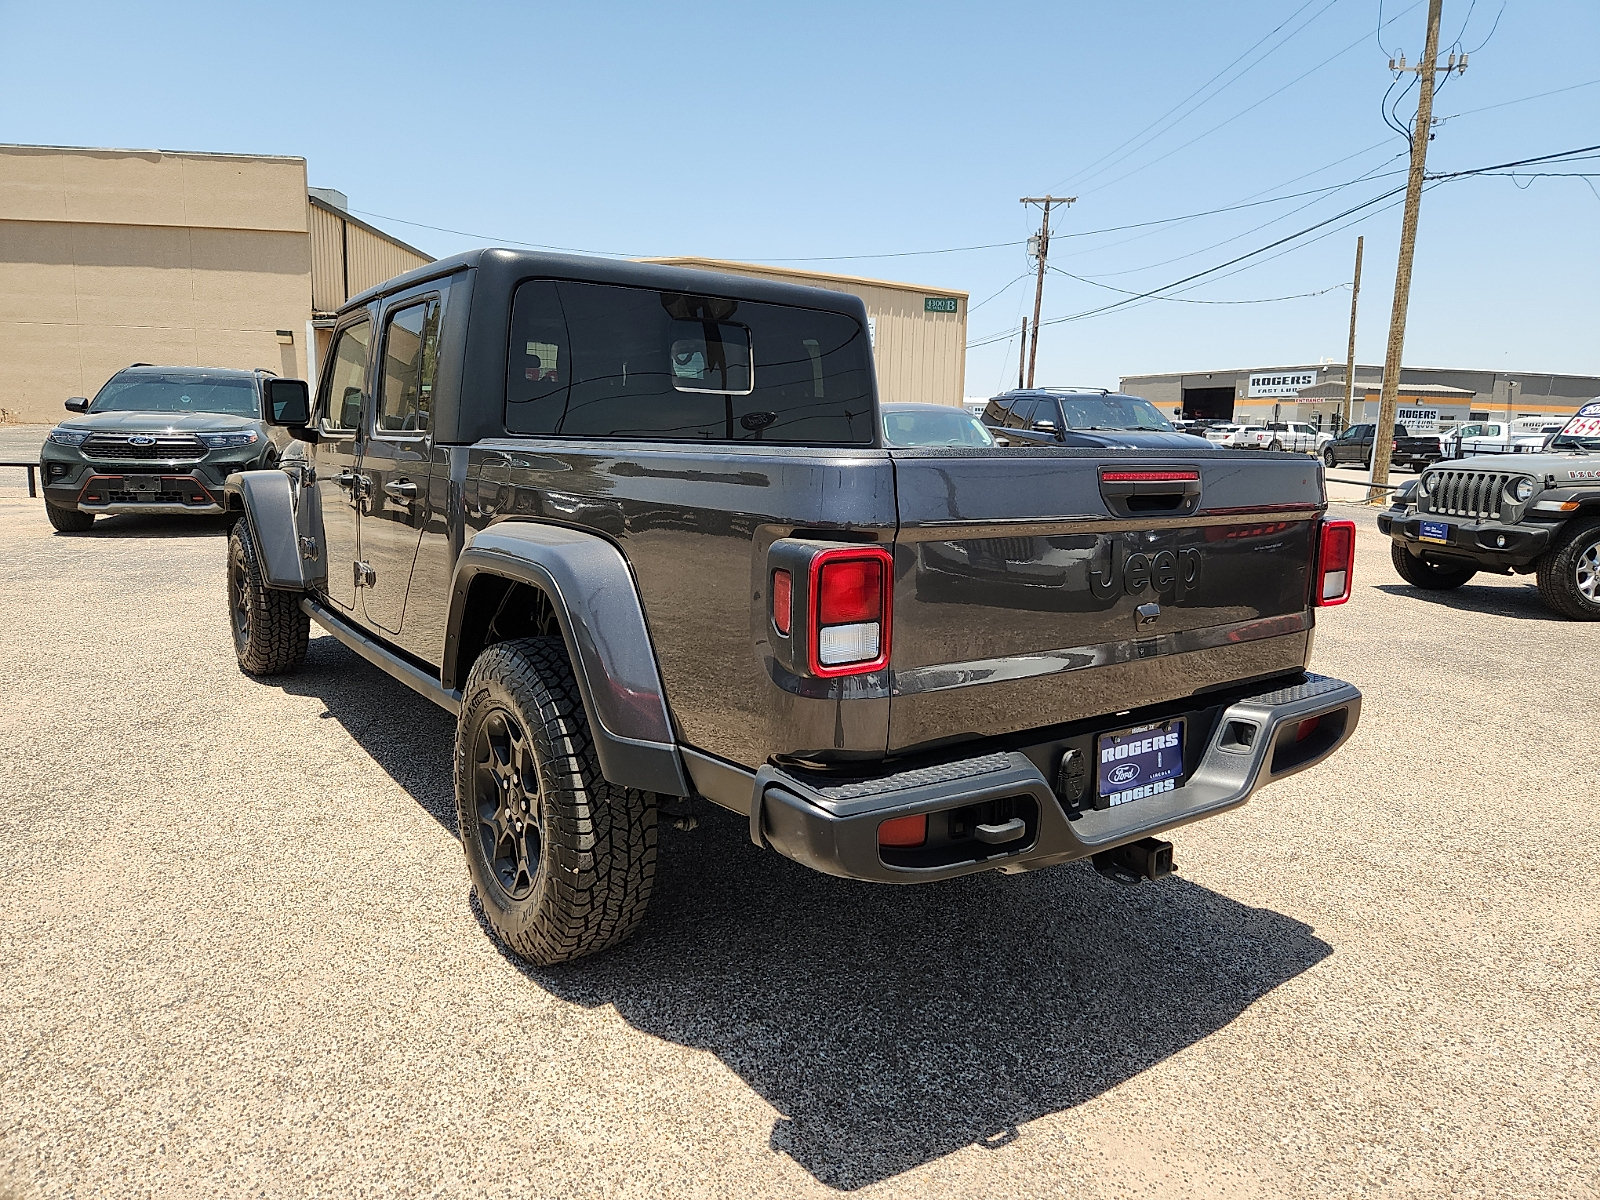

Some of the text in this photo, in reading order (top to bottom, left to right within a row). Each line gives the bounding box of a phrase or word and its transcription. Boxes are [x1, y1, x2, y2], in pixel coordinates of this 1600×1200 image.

[947, 300, 955, 310] B
[1251, 375, 1312, 386] ROGERS
[1399, 410, 1437, 419] ROGERS
[1089, 539, 1202, 602] Jeep
[1101, 732, 1179, 763] ROGERS
[1149, 769, 1171, 779] LINCOLN
[1109, 778, 1175, 807] ROGERS
